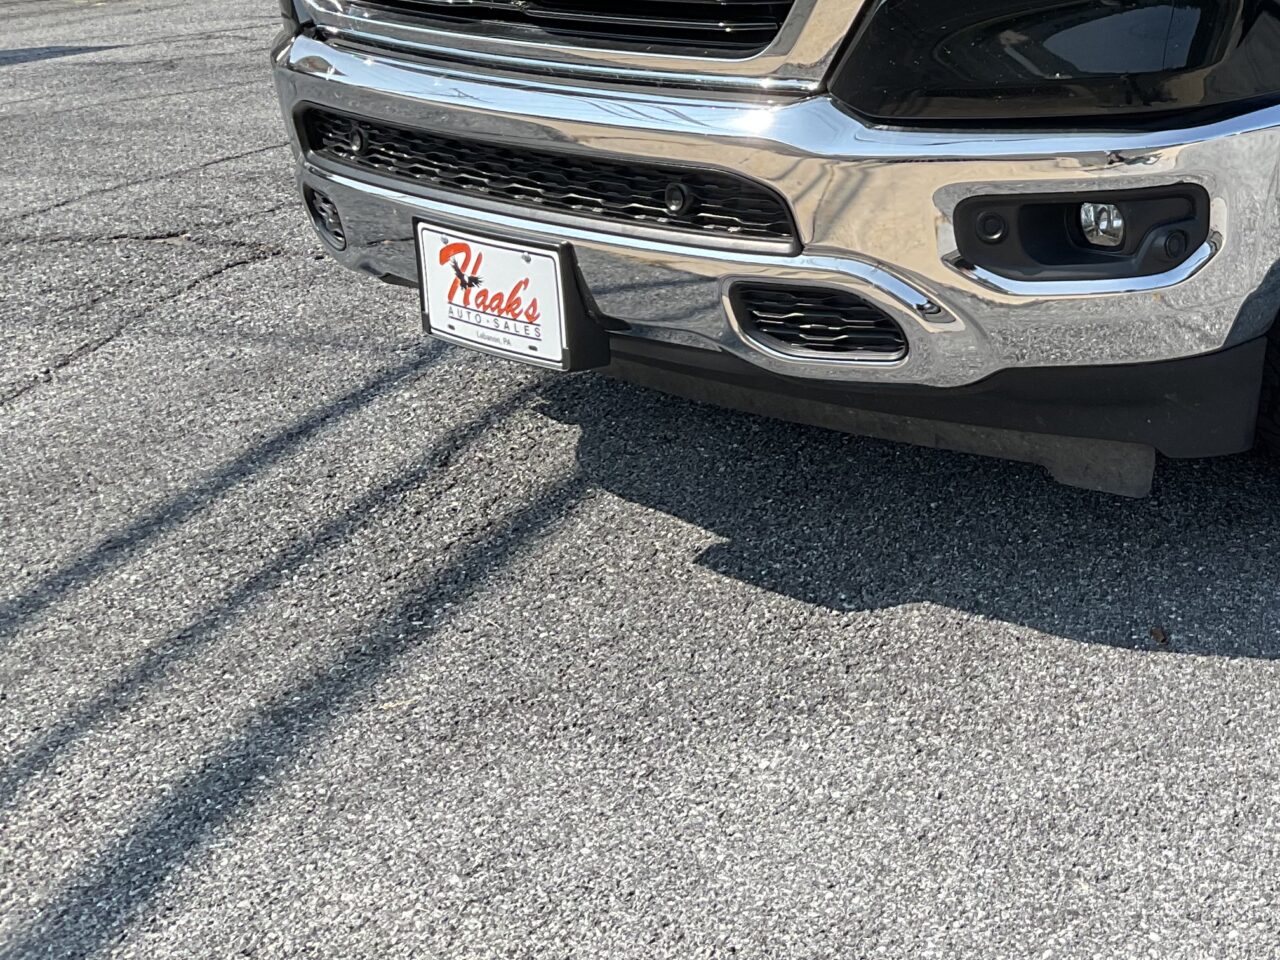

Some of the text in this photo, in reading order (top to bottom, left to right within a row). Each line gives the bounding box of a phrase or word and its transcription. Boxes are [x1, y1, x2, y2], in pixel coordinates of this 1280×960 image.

[449, 306, 541, 338] AUTO SALES
[503, 337, 512, 346] PA
